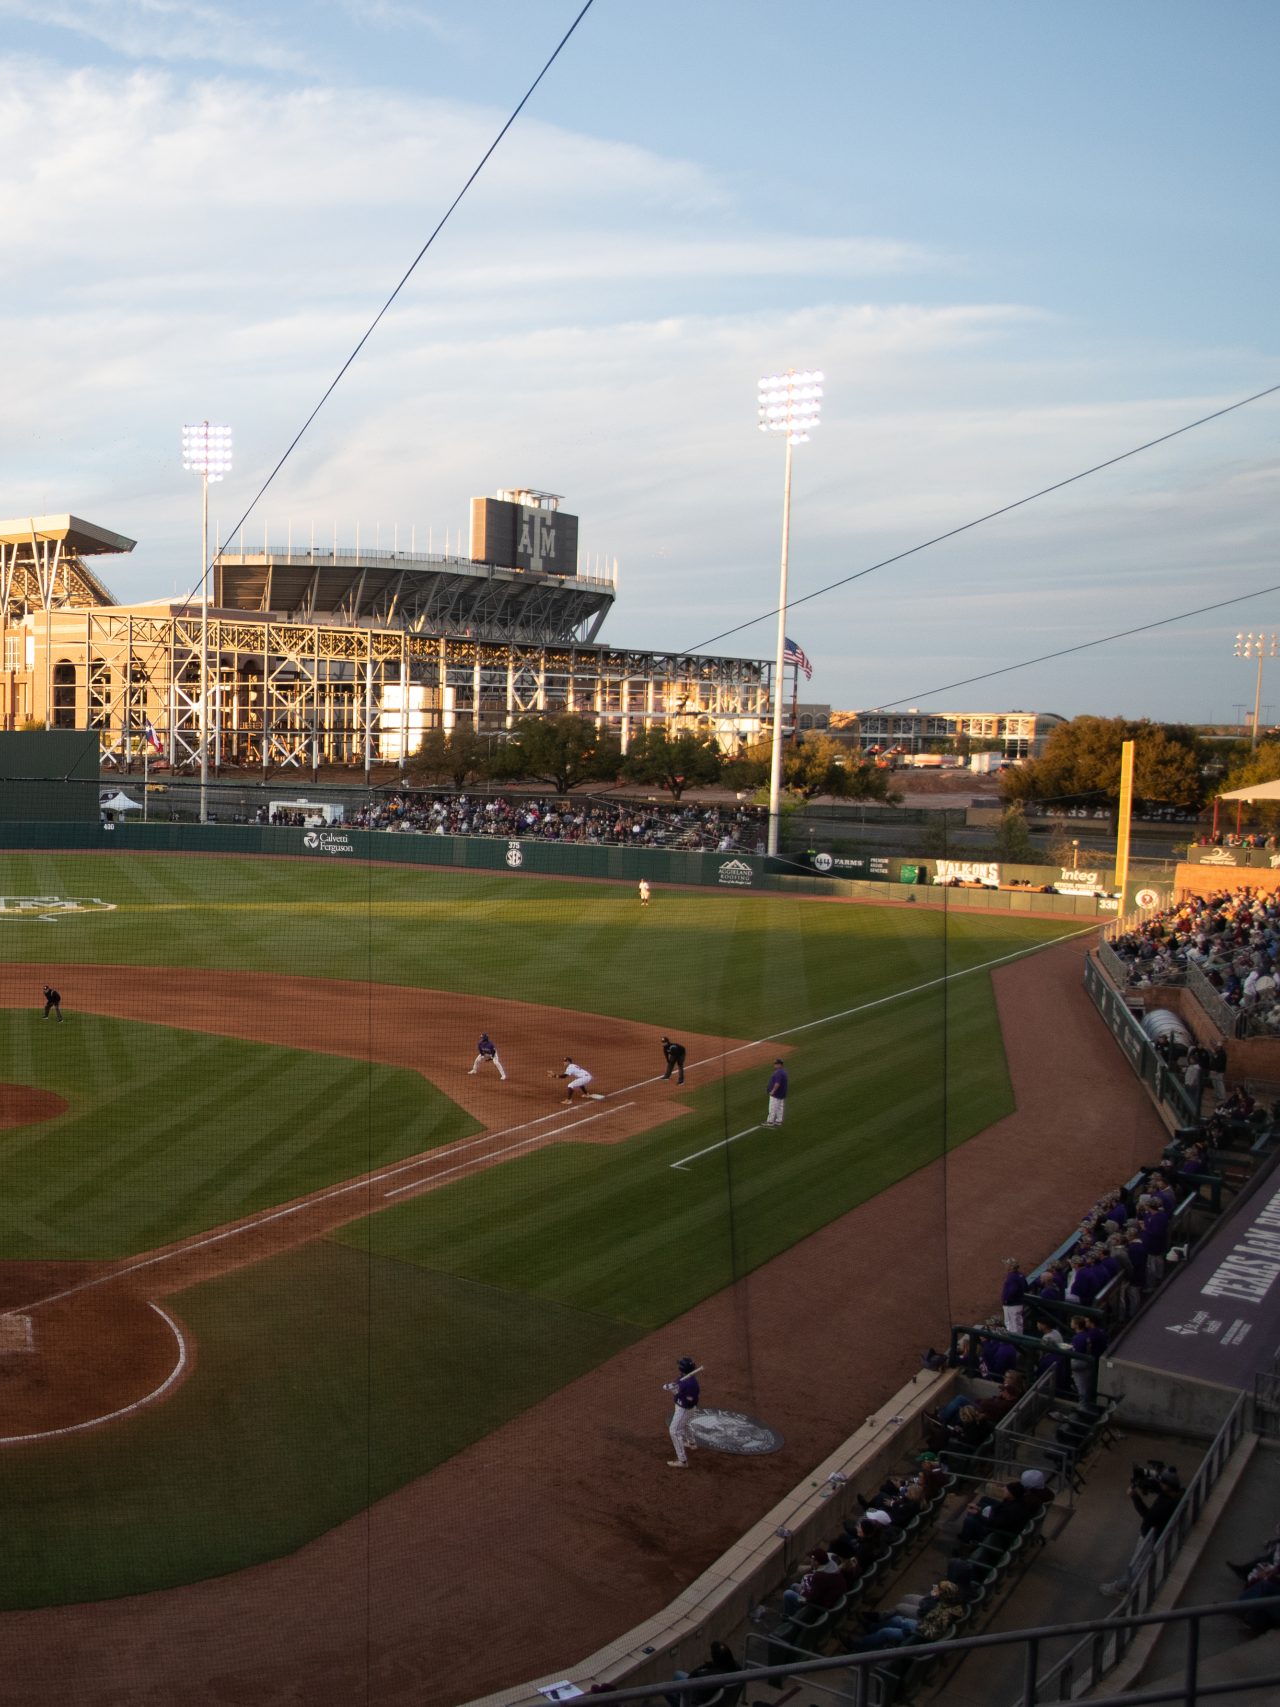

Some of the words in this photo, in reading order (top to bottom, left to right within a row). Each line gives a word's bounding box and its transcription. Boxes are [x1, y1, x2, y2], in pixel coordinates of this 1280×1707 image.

[320, 833, 348, 843] Calvetti
[320, 842, 353, 853] Ferguson
[507, 850, 521, 866] SEC
[834, 858, 862, 866] FARMS
[1099, 900, 1118, 909] 330
[1200, 1255, 1280, 1303] TEXAS
